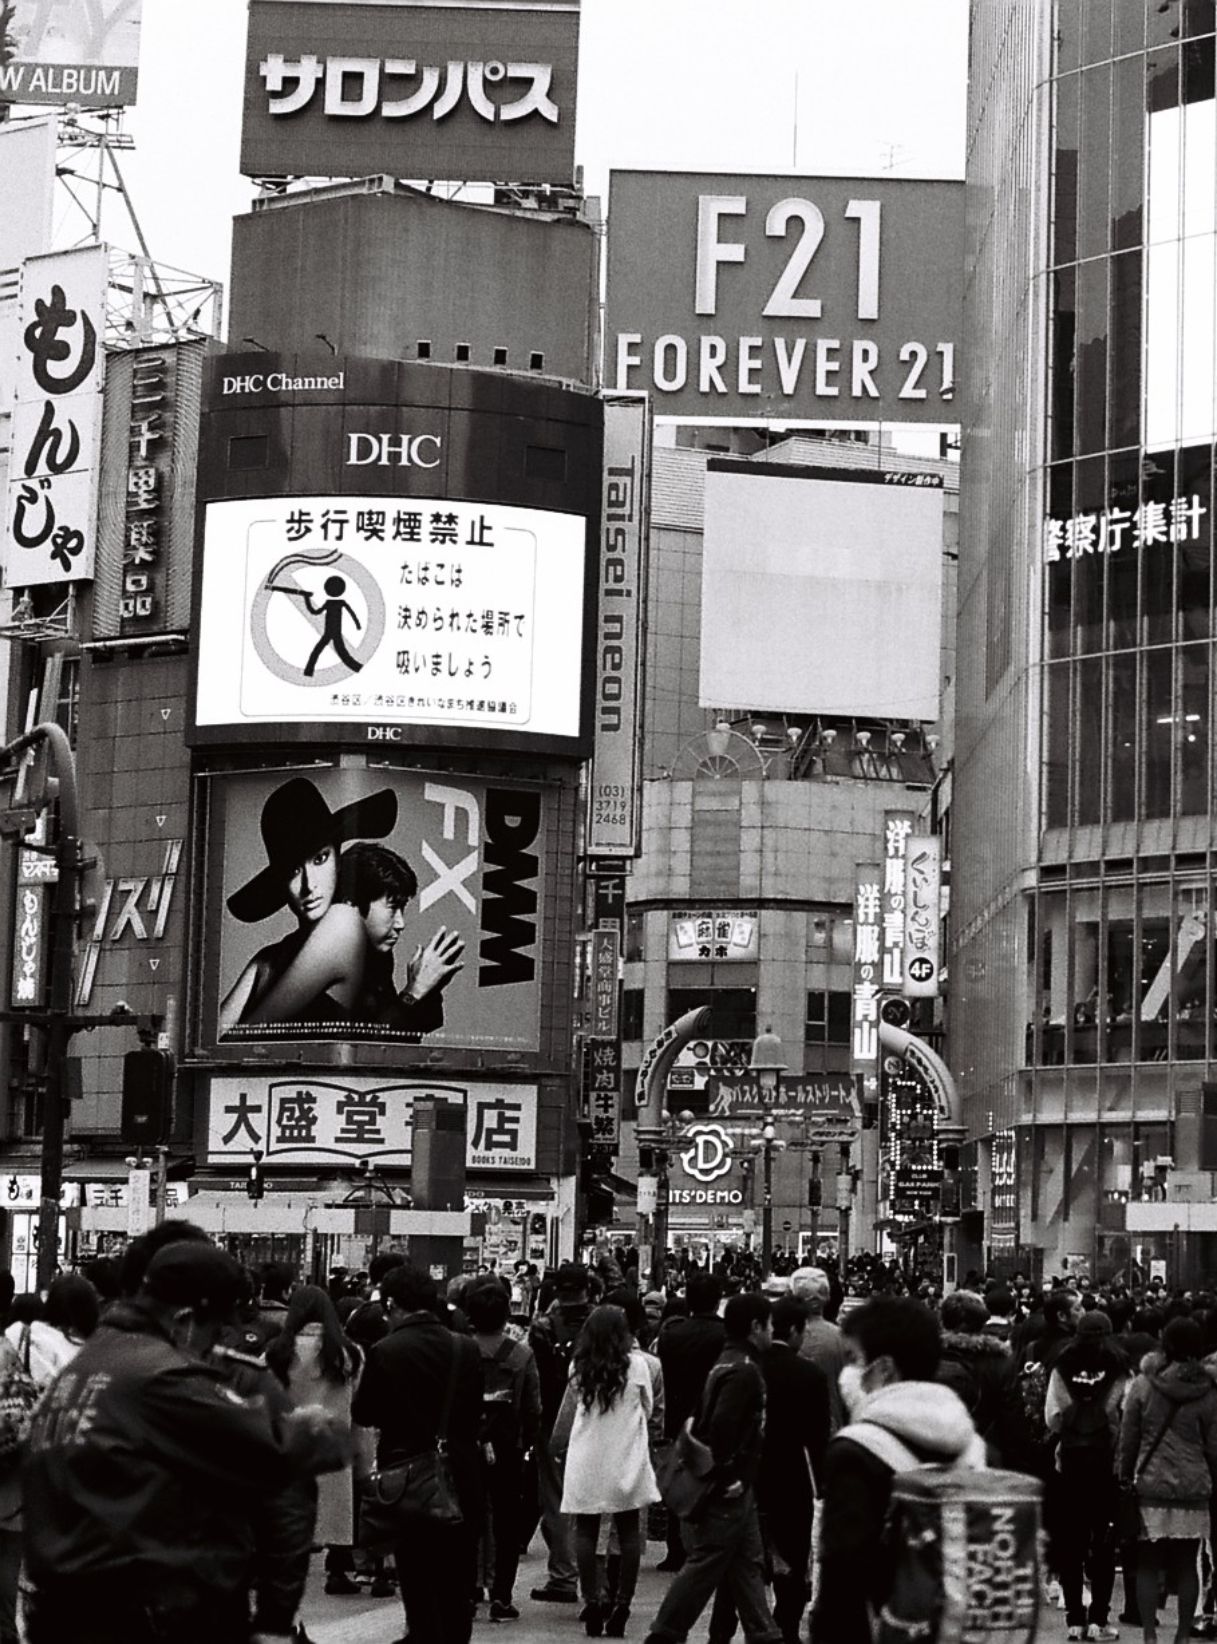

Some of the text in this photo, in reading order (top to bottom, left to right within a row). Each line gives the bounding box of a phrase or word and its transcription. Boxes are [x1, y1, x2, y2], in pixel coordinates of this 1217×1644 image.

[29, 67, 121, 95] ALBUM
[258, 53, 559, 123] サロンパス
[695, 194, 882, 320] F21
[222, 372, 345, 394] DHC Channel
[616, 333, 955, 399] FOREVER 21
[13, 284, 97, 573] もんじゃ
[346, 433, 442, 469] DHC
[119, 356, 164, 618] 三千里薬品
[285, 509, 496, 548] 歩行喫煙禁止
[1043, 493, 1207, 564] 警察庁集計
[399, 562, 464, 588] たばこは
[600, 455, 637, 733] Taisei neon
[396, 606, 526, 639] 決められた場所で
[396, 650, 493, 680] 吸いましょう
[367, 726, 402, 741] DHC
[595, 800, 627, 812] 3719
[598, 785, 626, 798] (03)
[595, 813, 626, 825] 2468
[419, 781, 479, 915] FX
[478, 787, 541, 987] DMM
[884, 820, 912, 984] 洋服の青山
[853, 883, 880, 1060] 洋服の青山
[909, 962, 932, 978] 4F
[593, 1046, 617, 1088] 焼肉
[221, 1090, 522, 1151] 大盛堂店
[472, 1155, 532, 1166] BOOKS TAISEIDO
[668, 1189, 743, 1204] ITS'DEMO
[988, 1507, 1016, 1628] NORTH
